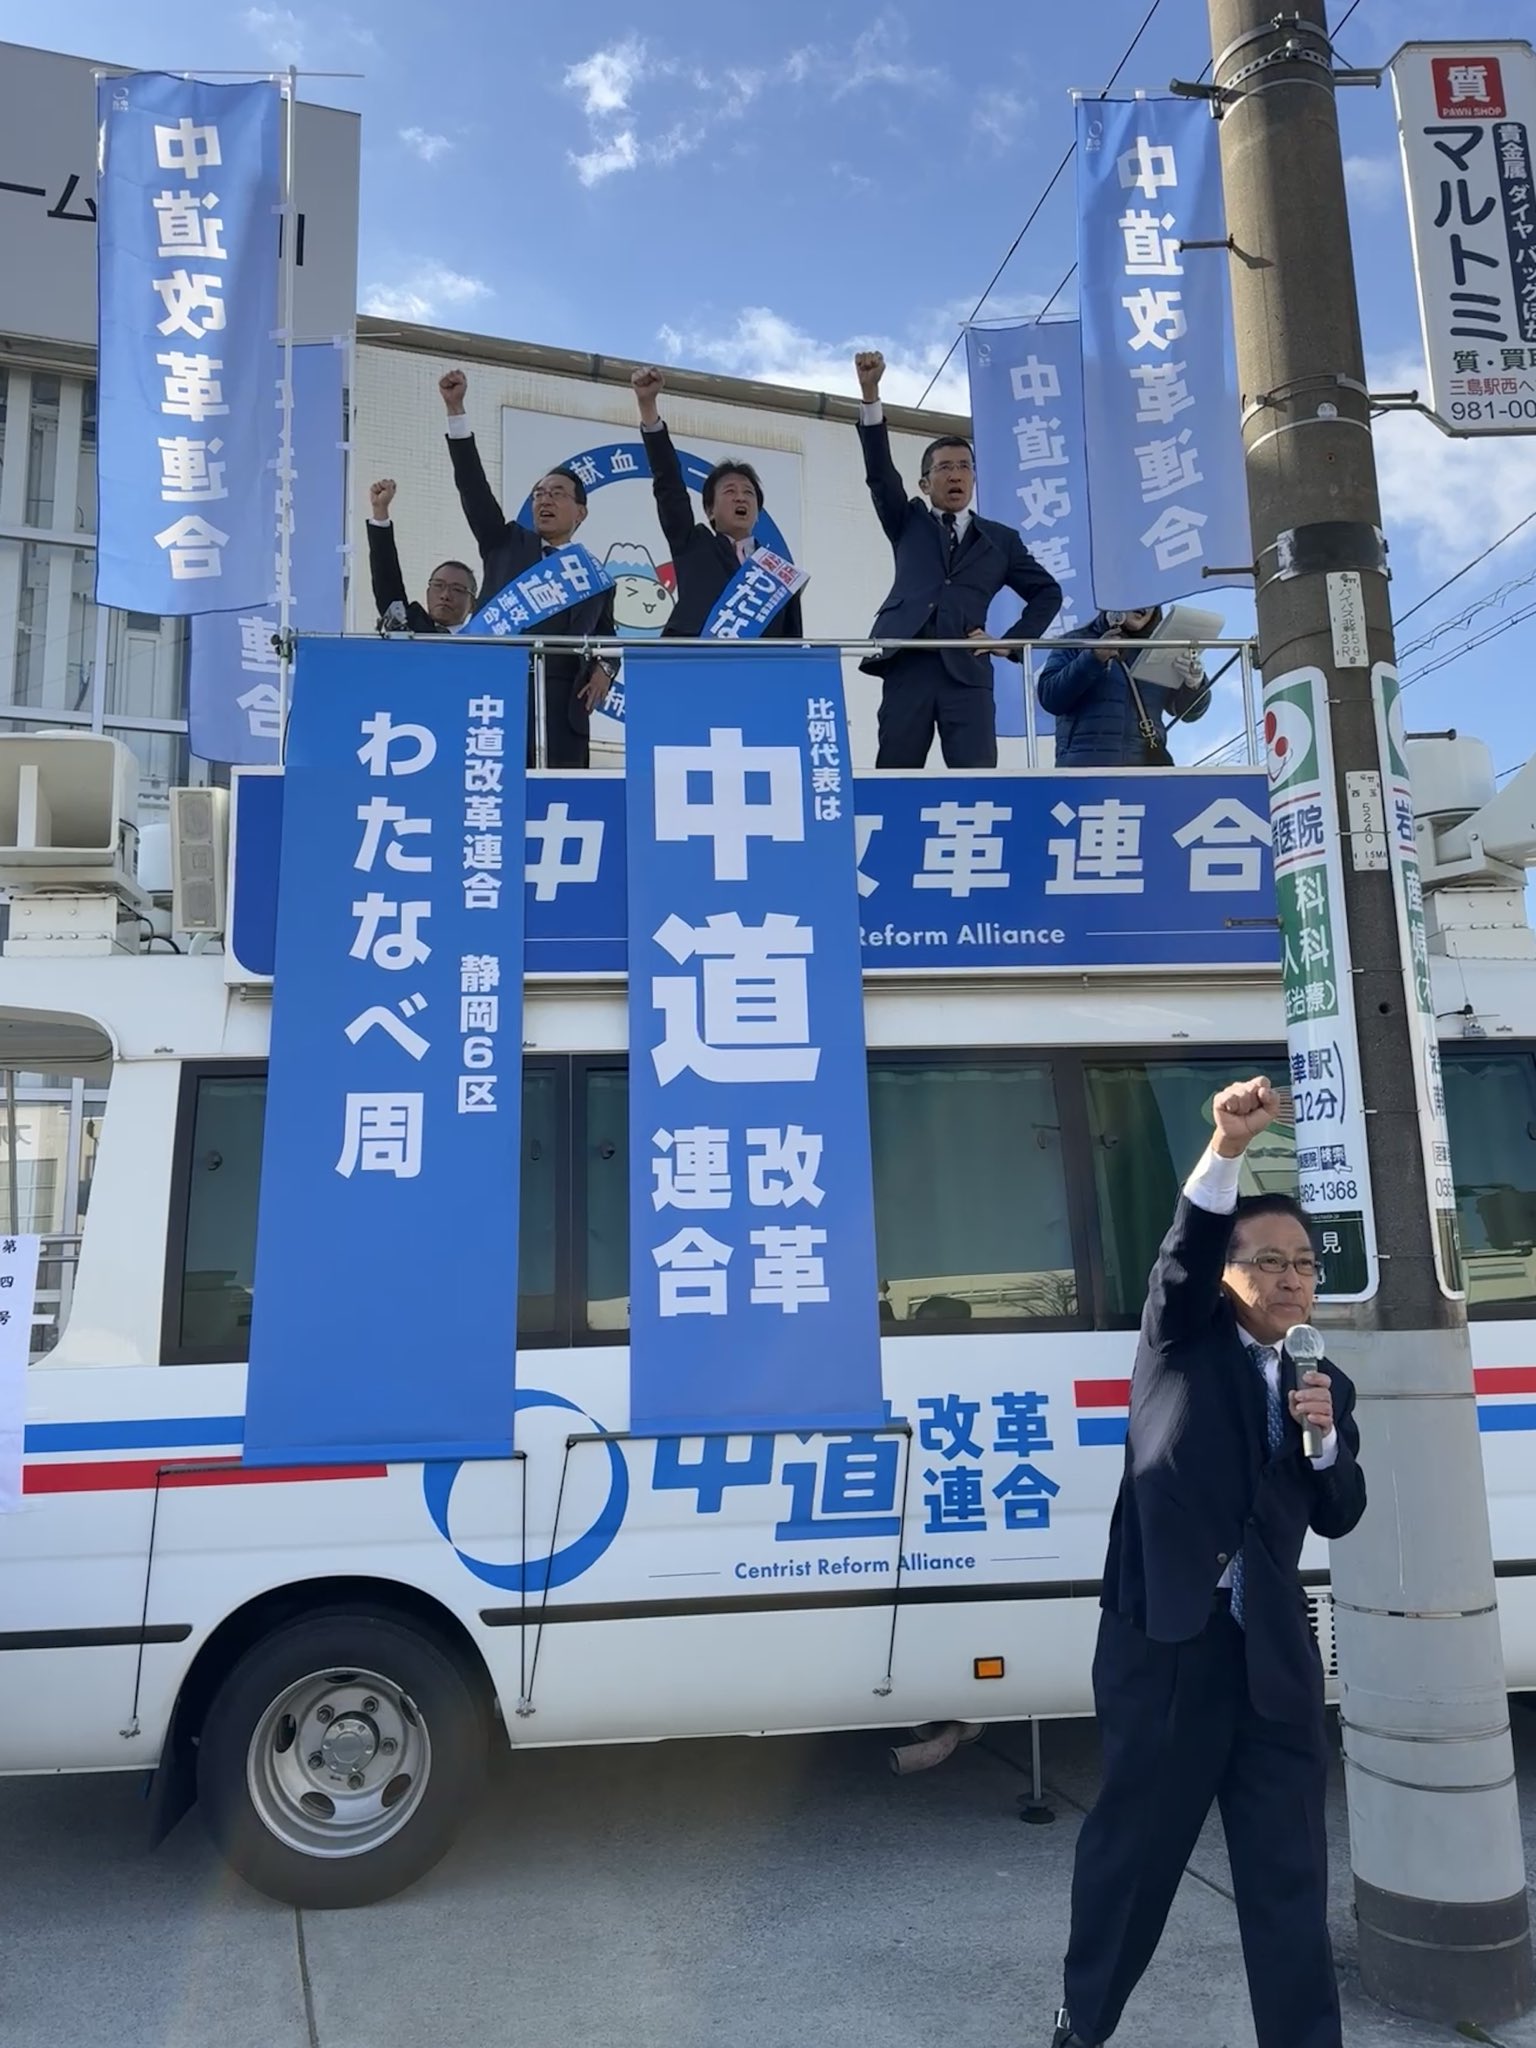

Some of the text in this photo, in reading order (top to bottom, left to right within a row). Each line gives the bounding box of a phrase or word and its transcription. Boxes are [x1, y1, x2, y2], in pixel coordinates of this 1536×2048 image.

[1442, 106, 1502, 117] PAWN SHOP
[1446, 64, 1491, 103] 質
[1498, 124, 1528, 180] 貴金属
[1423, 125, 1508, 342] マルトミ
[1508, 184, 1534, 240] ダイヤ
[569, 448, 639, 486] 献血
[516, 554, 591, 614] 中道
[710, 566, 777, 638] わたな
[806, 698, 841, 821] 比例代表は
[457, 695, 504, 1114] 中道改革連合 静岡6区
[651, 727, 822, 1087] 中道
[1295, 872, 1325, 919] 科
[335, 711, 438, 1179] わたなべ周
[957, 923, 1066, 945] Alliance
[651, 1126, 734, 1317] 連合
[746, 1124, 830, 1313] 改革
[1322, 1231, 1341, 1254] 見
[917, 1391, 1054, 1458] 改革
[921, 1464, 1060, 1534] 連合
[734, 1552, 977, 1580] Centrist Reform Alliance
